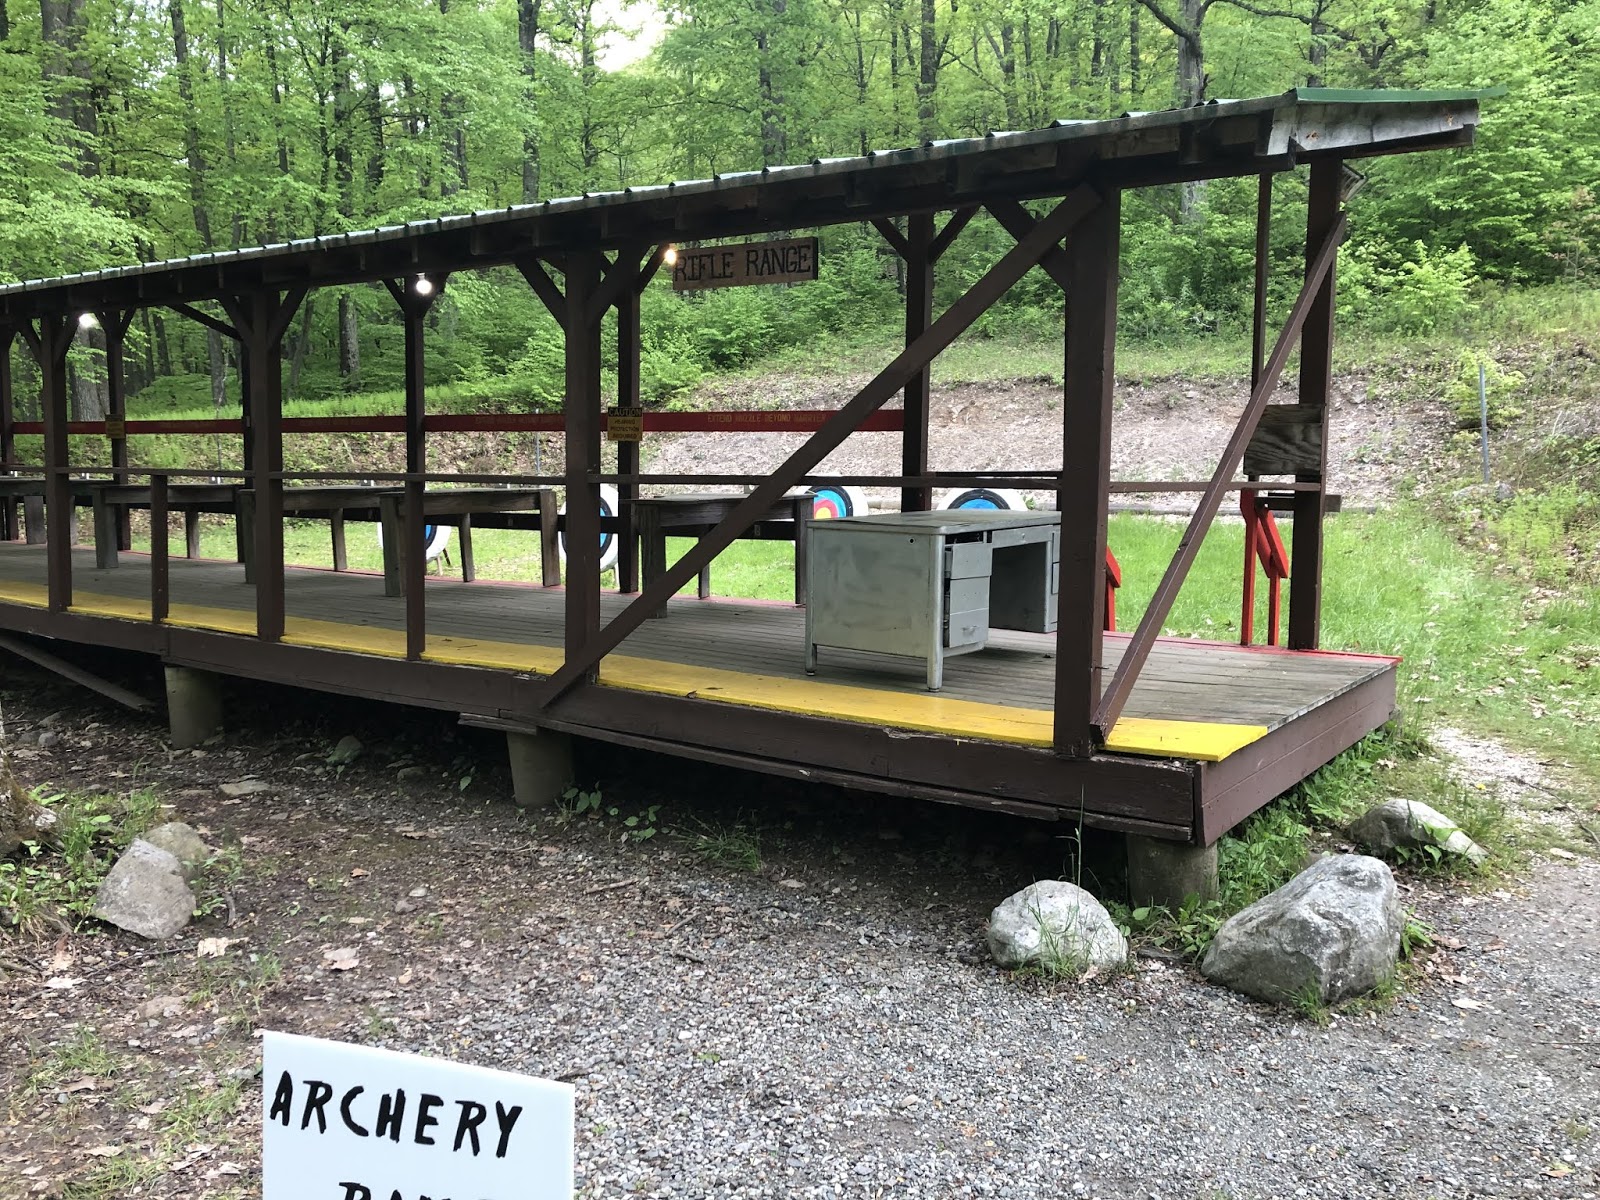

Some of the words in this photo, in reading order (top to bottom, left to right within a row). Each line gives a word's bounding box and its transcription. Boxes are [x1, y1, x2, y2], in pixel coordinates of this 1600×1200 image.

[674, 252, 734, 282] RIFLE
[746, 244, 811, 276] RANGE
[608, 408, 641, 417] CAUTION
[707, 413, 732, 423] EXTEND
[764, 413, 791, 422] BEYOND
[270, 1070, 523, 1158] ARCHERY
